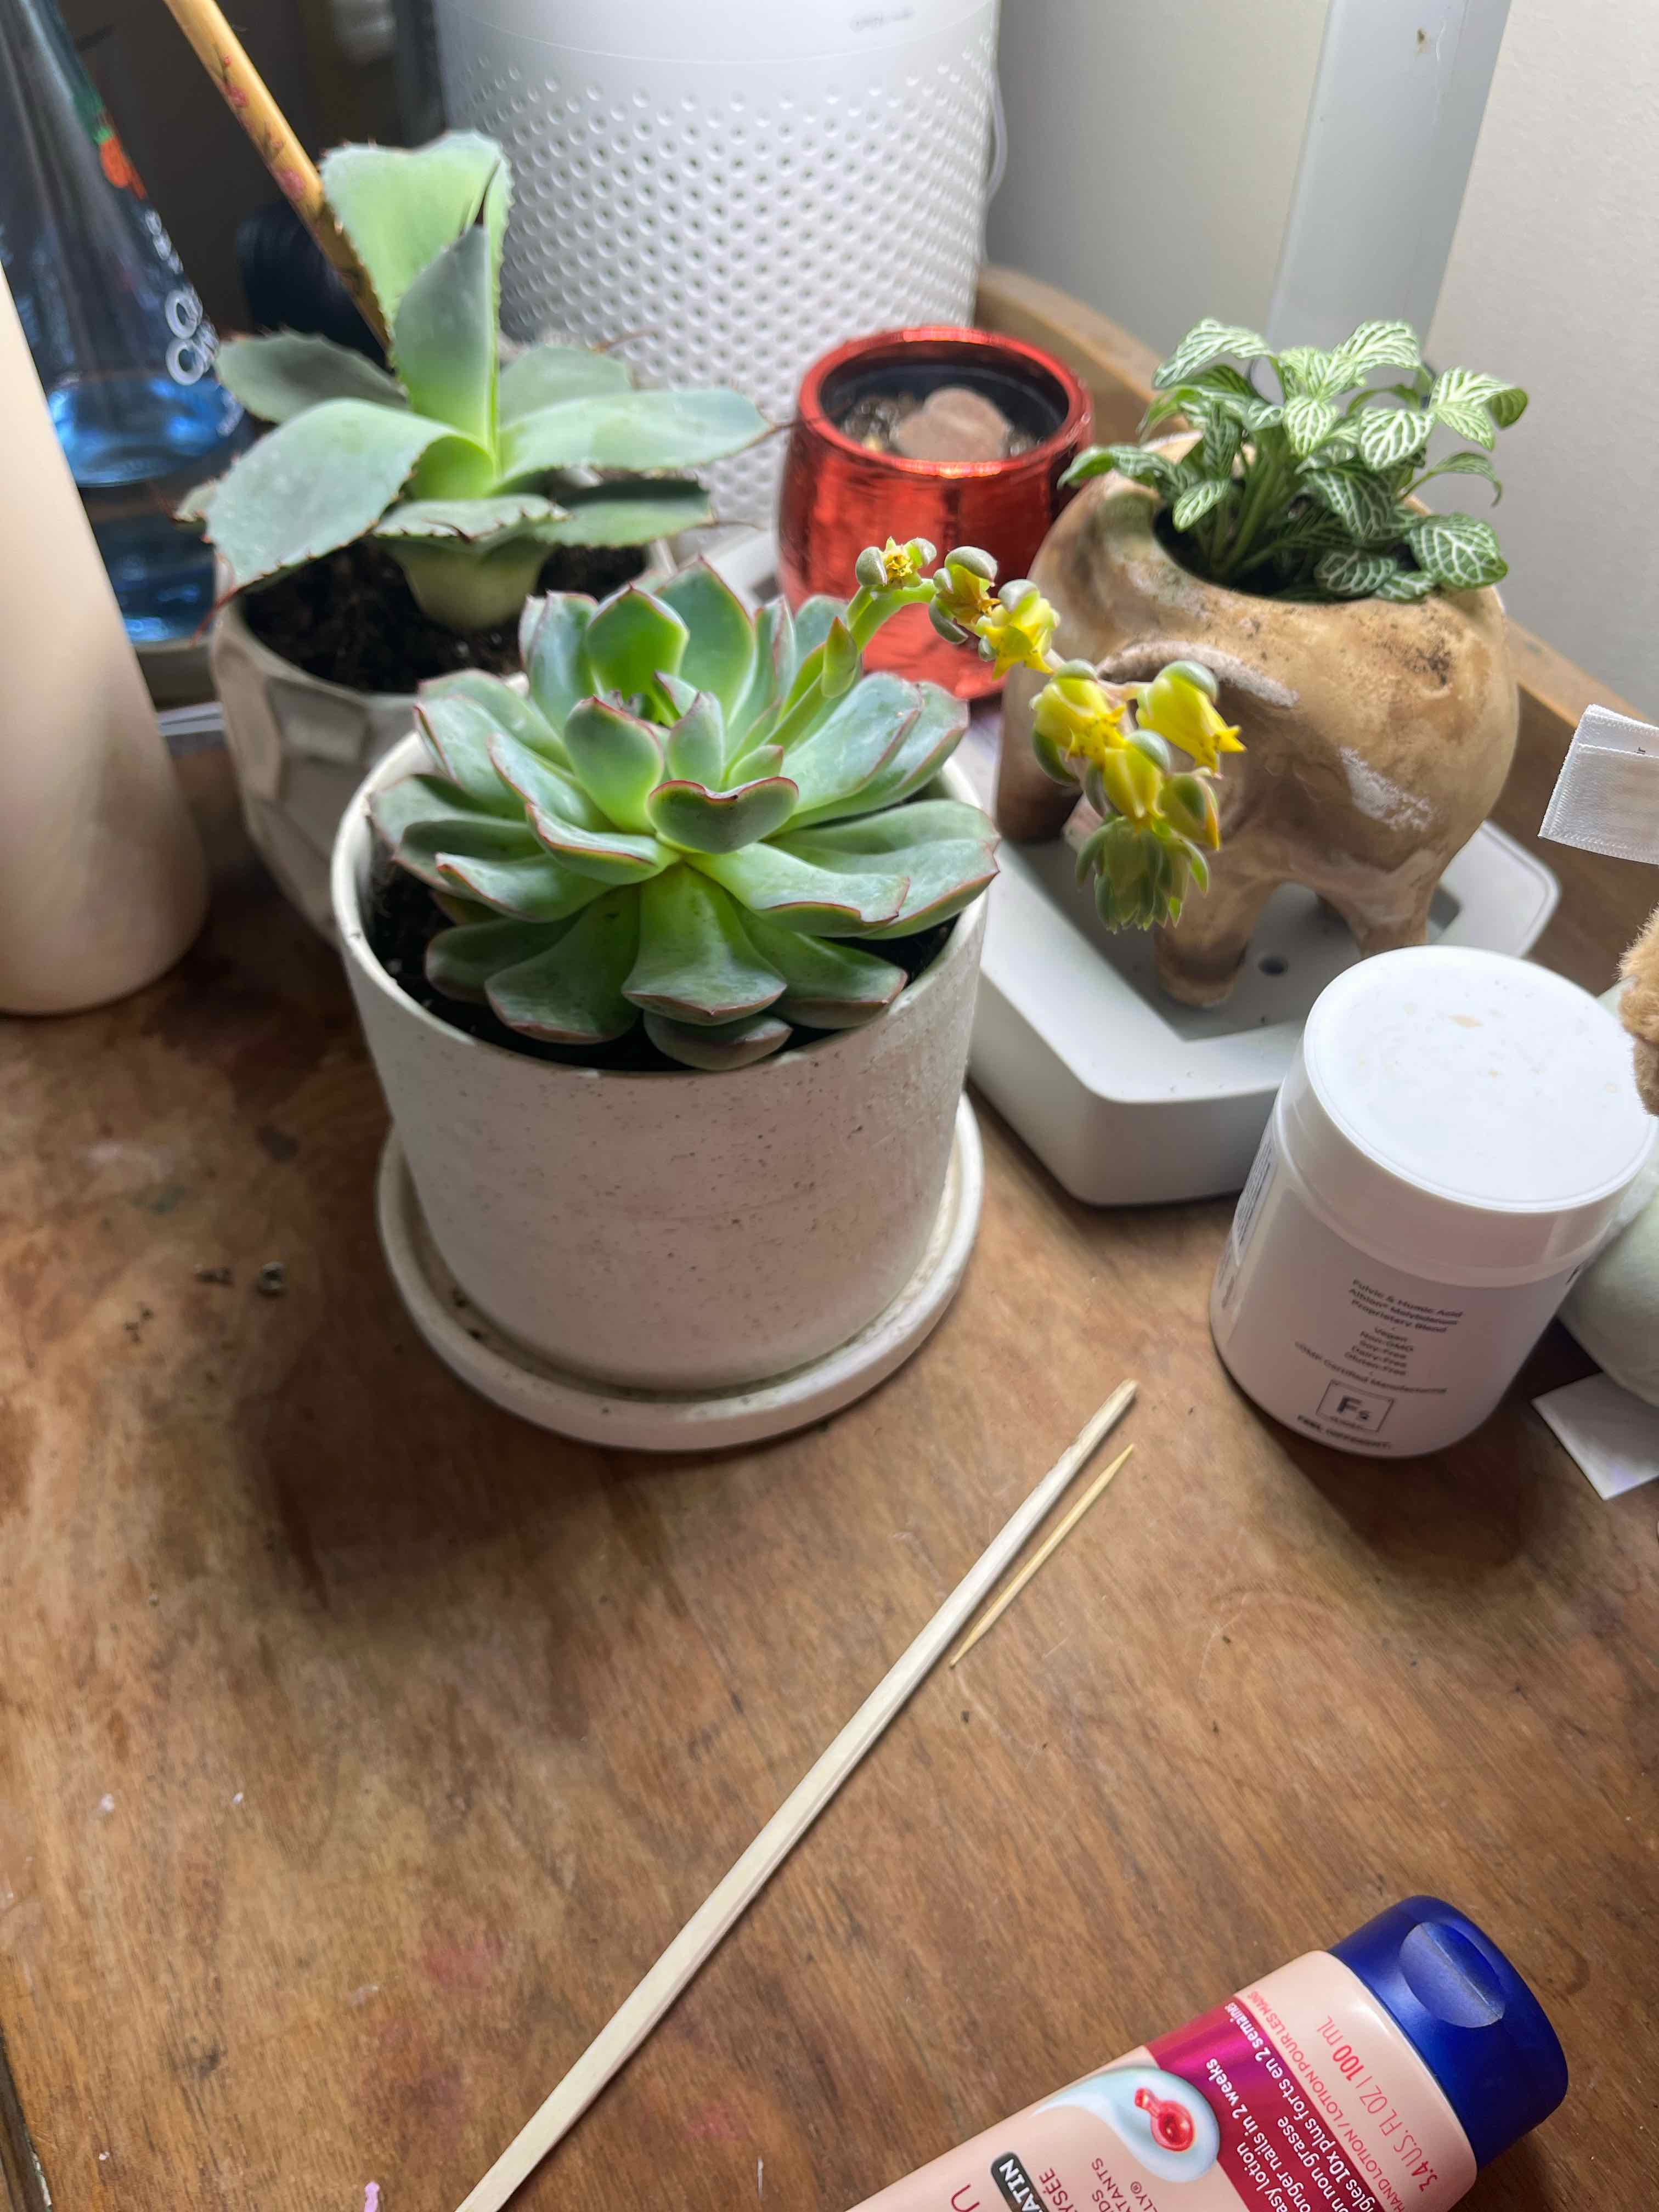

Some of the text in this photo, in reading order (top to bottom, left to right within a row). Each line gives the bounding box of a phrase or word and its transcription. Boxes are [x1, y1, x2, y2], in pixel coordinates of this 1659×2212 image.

[1375, 1328, 1407, 1342] Vegan
[1225, 2002, 1263, 2049] semaines
[1266, 2013, 1285, 2035] LES
[1255, 2047, 1271, 2061] 2
[1266, 2058, 1283, 2078] en
[1280, 2033, 1310, 2072] POUR
[1333, 2045, 1364, 2080] 100
[1206, 2059, 1239, 2106] weeks
[1279, 2079, 1308, 2121] forts
[1305, 2070, 1343, 2121] LOTION
[1359, 2085, 1387, 2114] OZ
[1233, 2104, 1247, 2118] 2
[1243, 2115, 1258, 2136] in
[1379, 2109, 1402, 2136] FL
[1254, 2133, 1282, 2170] nails
[1278, 2117, 1319, 2167] grasse
[1305, 2118, 1335, 2153] plus
[1393, 2130, 1422, 2167] U.S.
[1237, 2142, 1269, 2191] lotion
[1327, 2151, 1350, 2182] 10x
[1344, 2129, 1383, 2179] LOTION
[999, 2159, 1042, 2212] ATIN
[1312, 2168, 1335, 2199] non
[1412, 2161, 1437, 2192] 3.4
[1378, 2179, 1405, 2212] HAND
